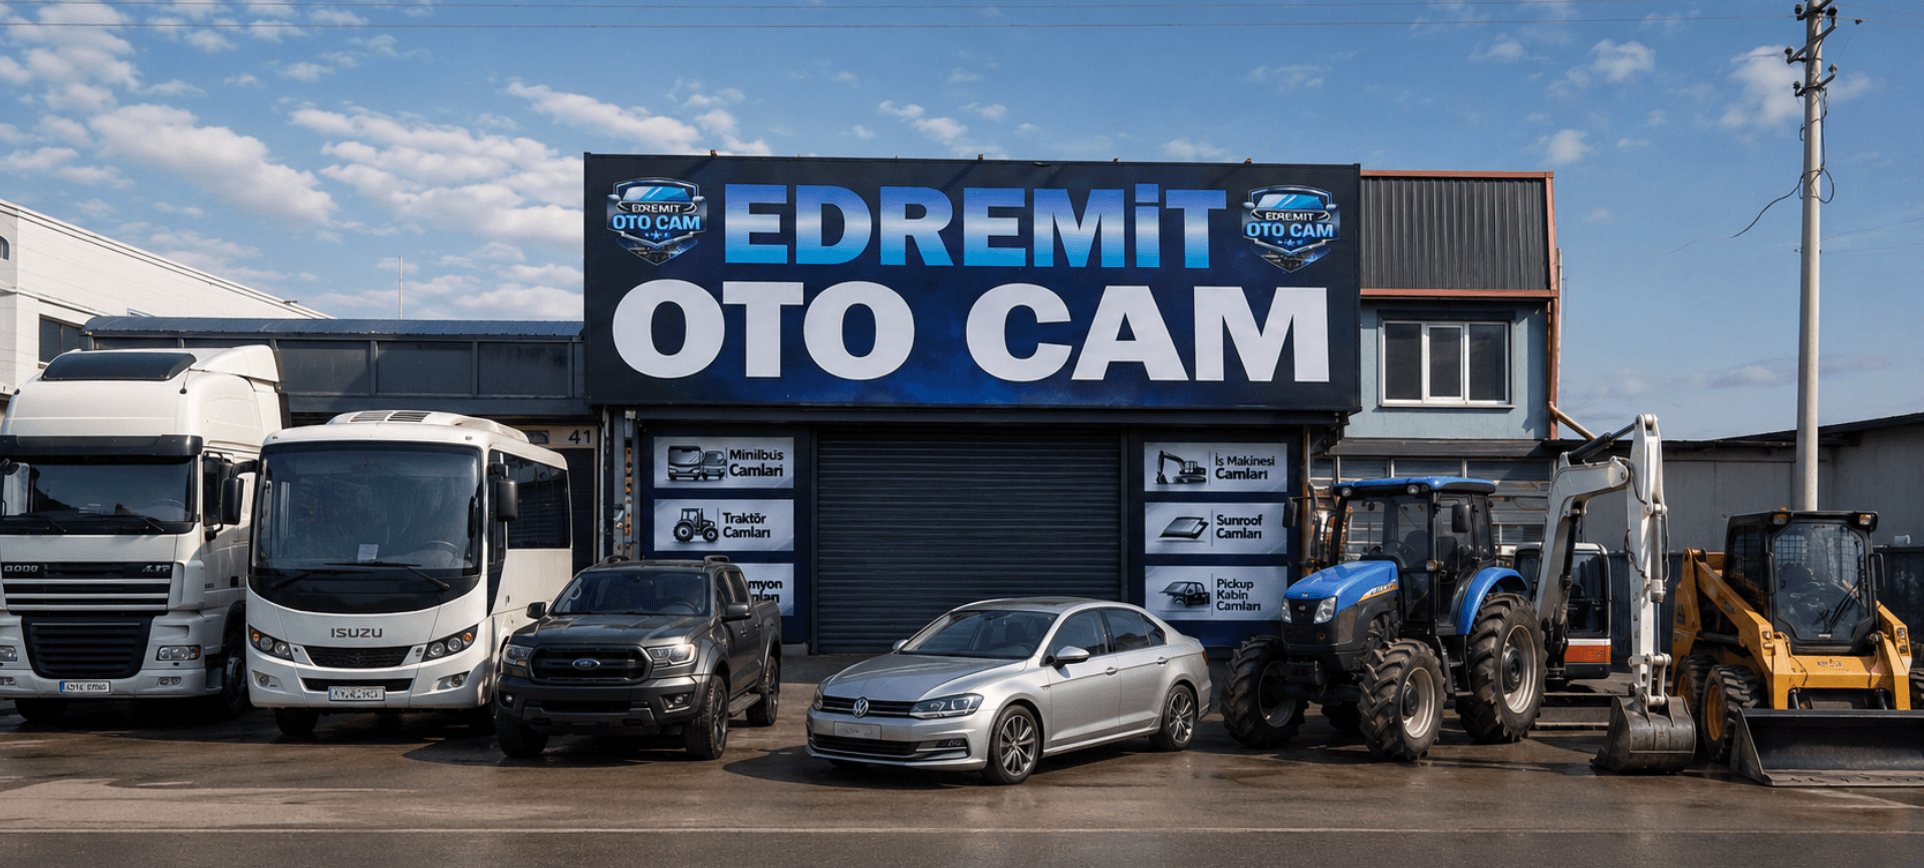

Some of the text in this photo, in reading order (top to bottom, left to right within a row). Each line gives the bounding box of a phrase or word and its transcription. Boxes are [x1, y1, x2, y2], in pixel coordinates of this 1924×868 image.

[612, 214, 700, 230] OTO CAM
[1246, 222, 1334, 238] OTO CAM
[612, 279, 1330, 382] OTO CAM
[568, 429, 591, 445] 41
[1227, 455, 1275, 466] Makinesi
[1216, 514, 1263, 526] Sunroof
[1217, 578, 1254, 590] Pickup
[1217, 590, 1248, 600] Kabin
[331, 628, 383, 638] ISUZU
